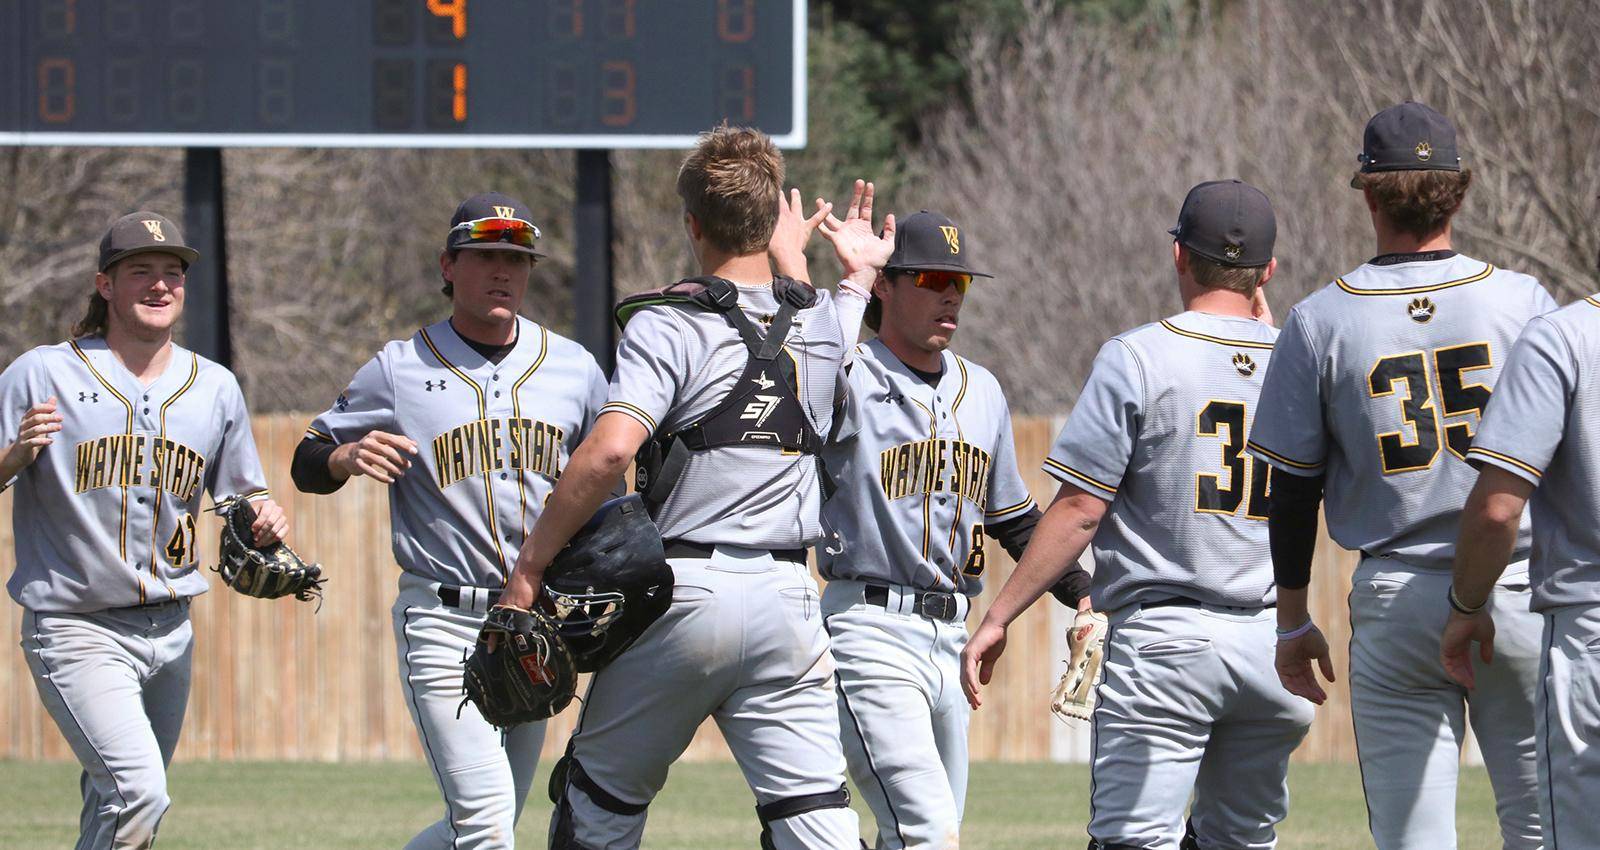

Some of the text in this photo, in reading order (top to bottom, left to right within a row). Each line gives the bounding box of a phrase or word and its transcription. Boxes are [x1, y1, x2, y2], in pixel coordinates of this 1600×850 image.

[38, 57, 76, 123] 0
[452, 62, 468, 123] 1
[602, 60, 637, 126] 3
[1367, 342, 1493, 474] 35
[74, 433, 205, 504] WAYNE STATE
[432, 418, 504, 492] WAYNE
[879, 438, 992, 513] WAYNE STAT
[164, 512, 197, 568] 41
[961, 521, 986, 579] 8
